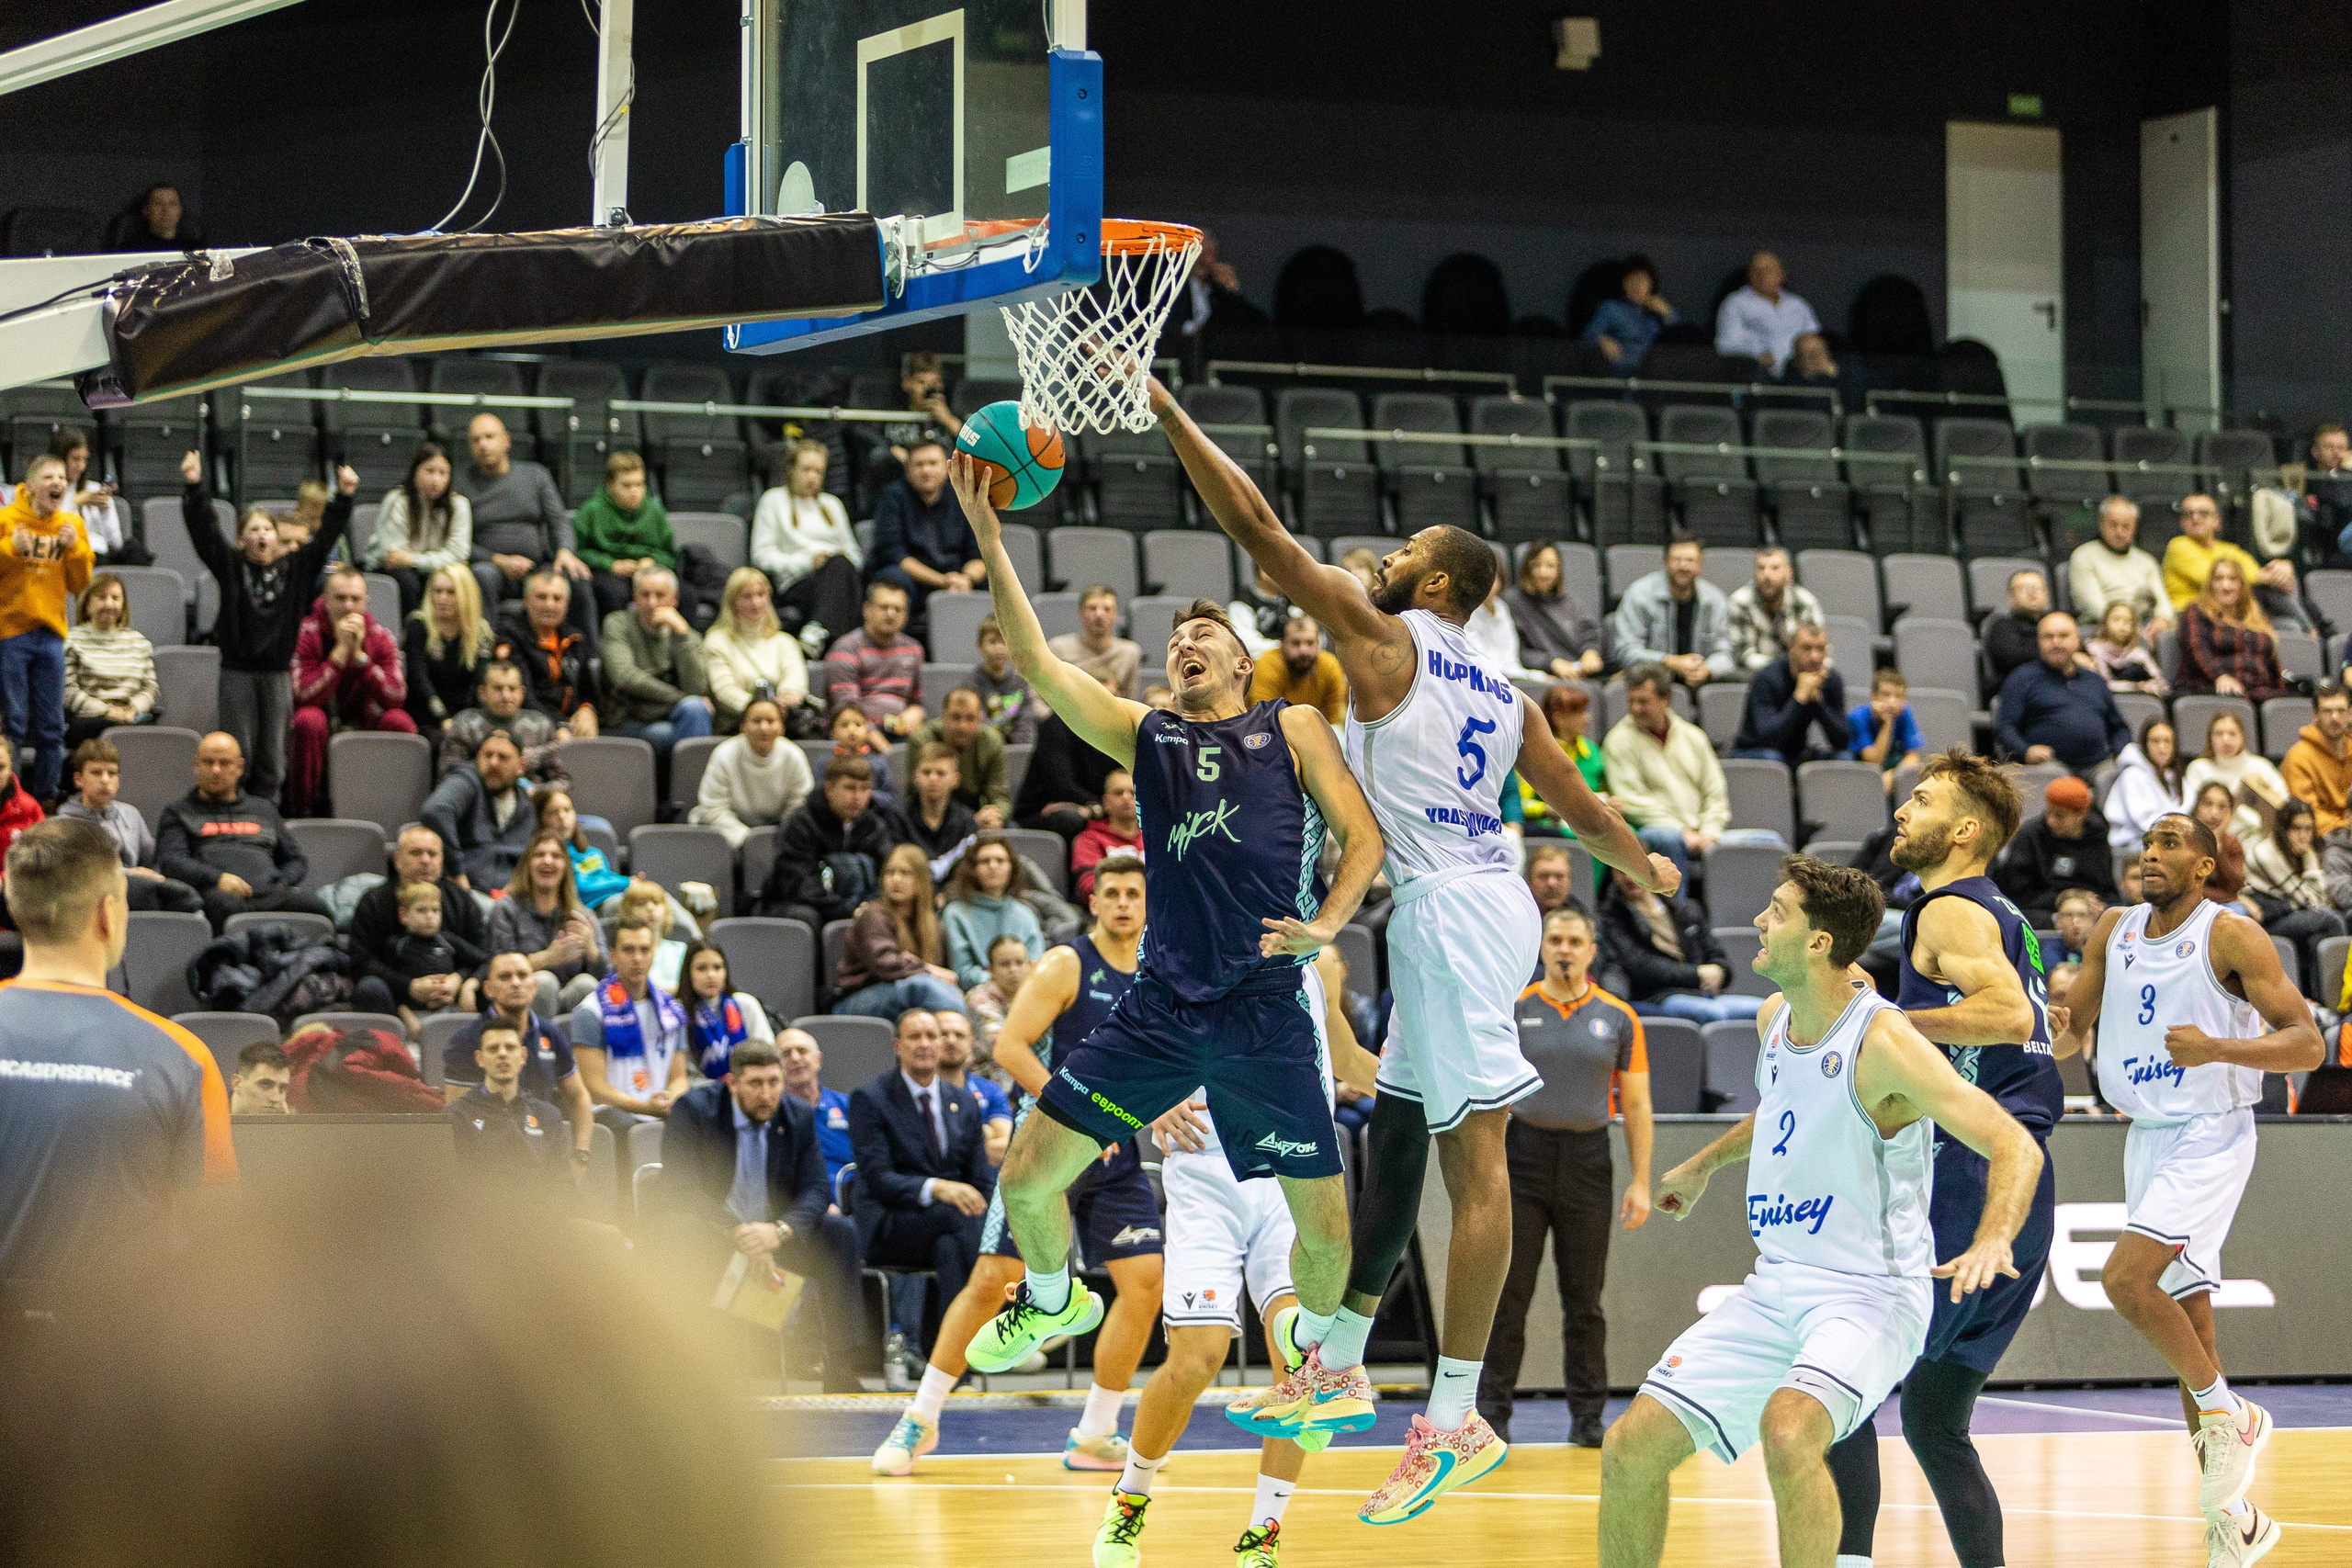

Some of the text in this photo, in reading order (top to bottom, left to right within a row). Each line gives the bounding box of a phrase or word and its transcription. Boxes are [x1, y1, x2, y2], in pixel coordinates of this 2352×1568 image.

[1155, 733, 1189, 745] Kempa
[1456, 716, 1497, 790] 5
[1196, 747, 1221, 782] 5
[2138, 984, 2156, 1025] 3
[1058, 1066, 1090, 1095] Kempa
[1772, 1110, 1795, 1156] 2
[1747, 1193, 1834, 1237] Enisey
